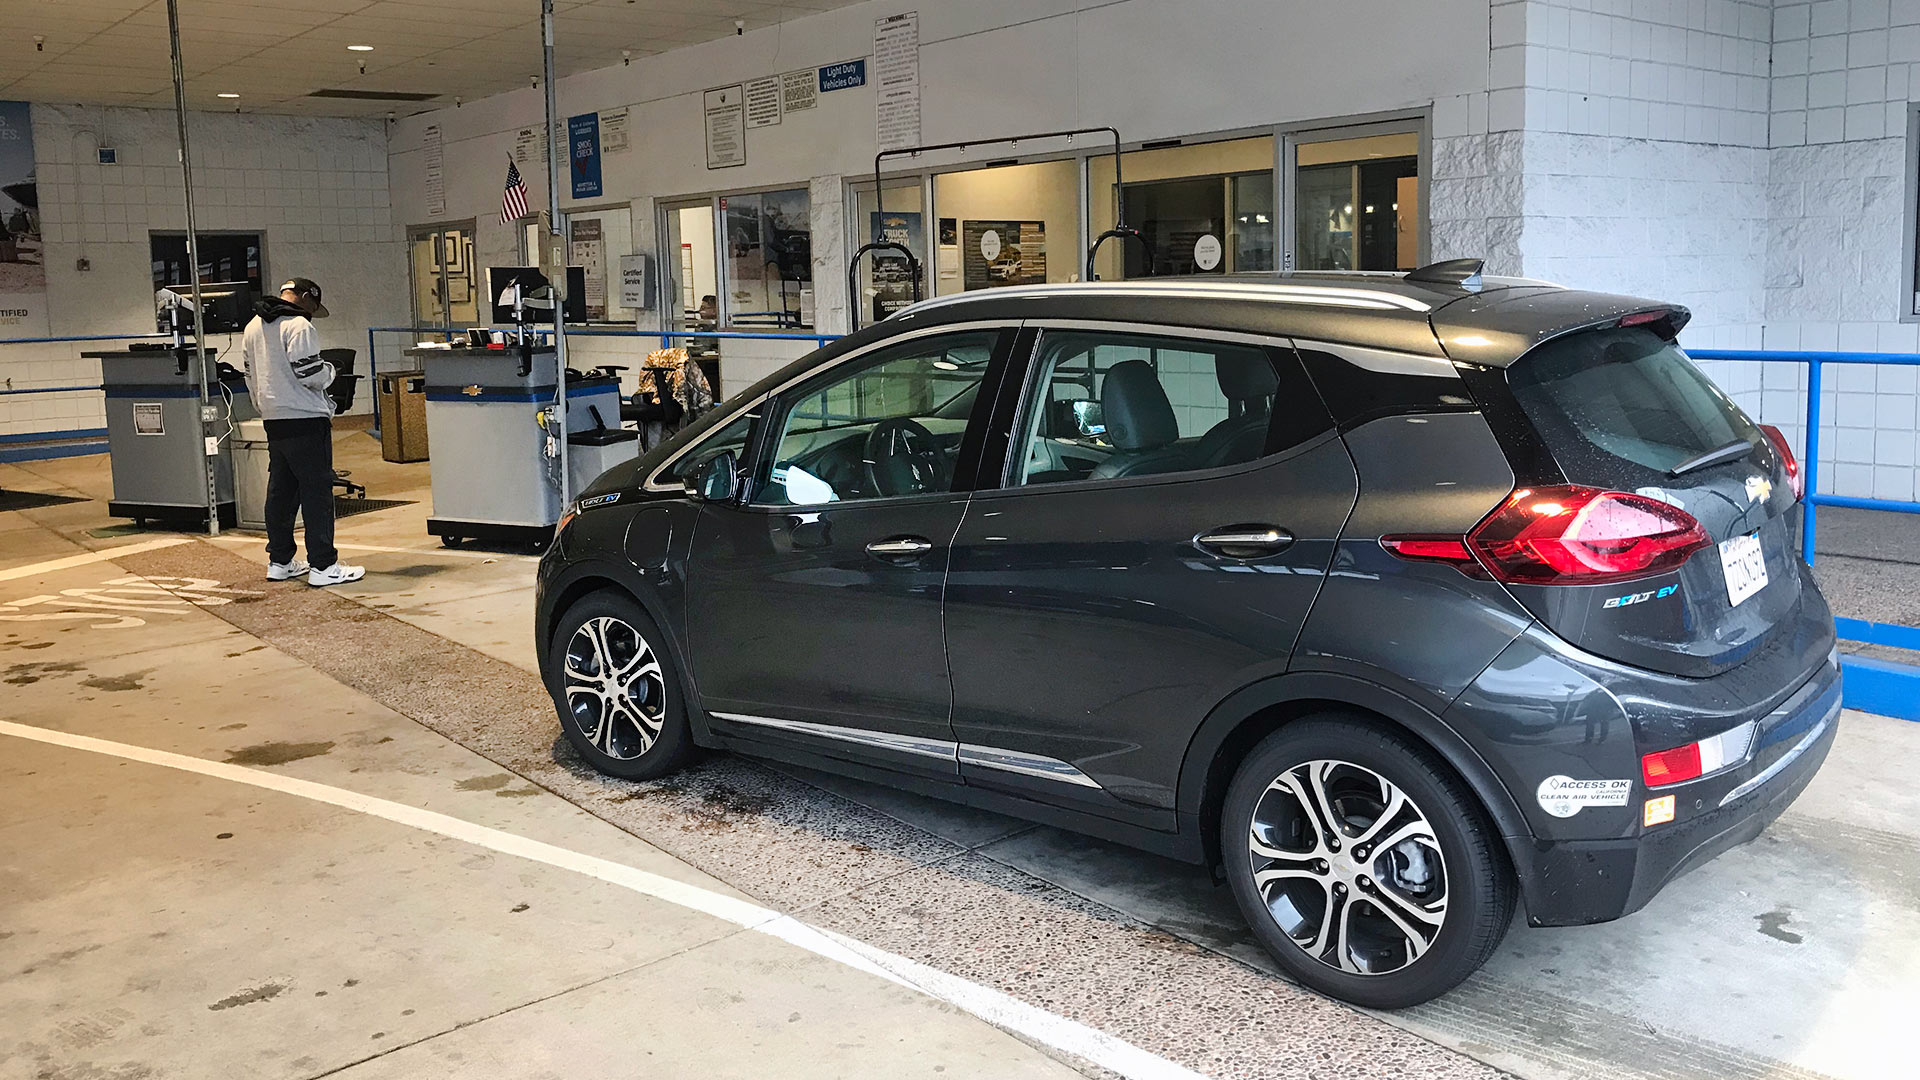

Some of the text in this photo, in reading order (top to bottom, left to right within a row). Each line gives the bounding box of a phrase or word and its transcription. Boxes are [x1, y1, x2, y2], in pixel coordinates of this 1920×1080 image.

[826, 64, 856, 78] Light Duty
[823, 75, 862, 89] Vehicles Only
[623, 269, 642, 277] Certified
[0, 309, 28, 317] TIFIED
[1602, 583, 1679, 609] BOLT EV
[1559, 781, 1628, 789] ACCESS OK
